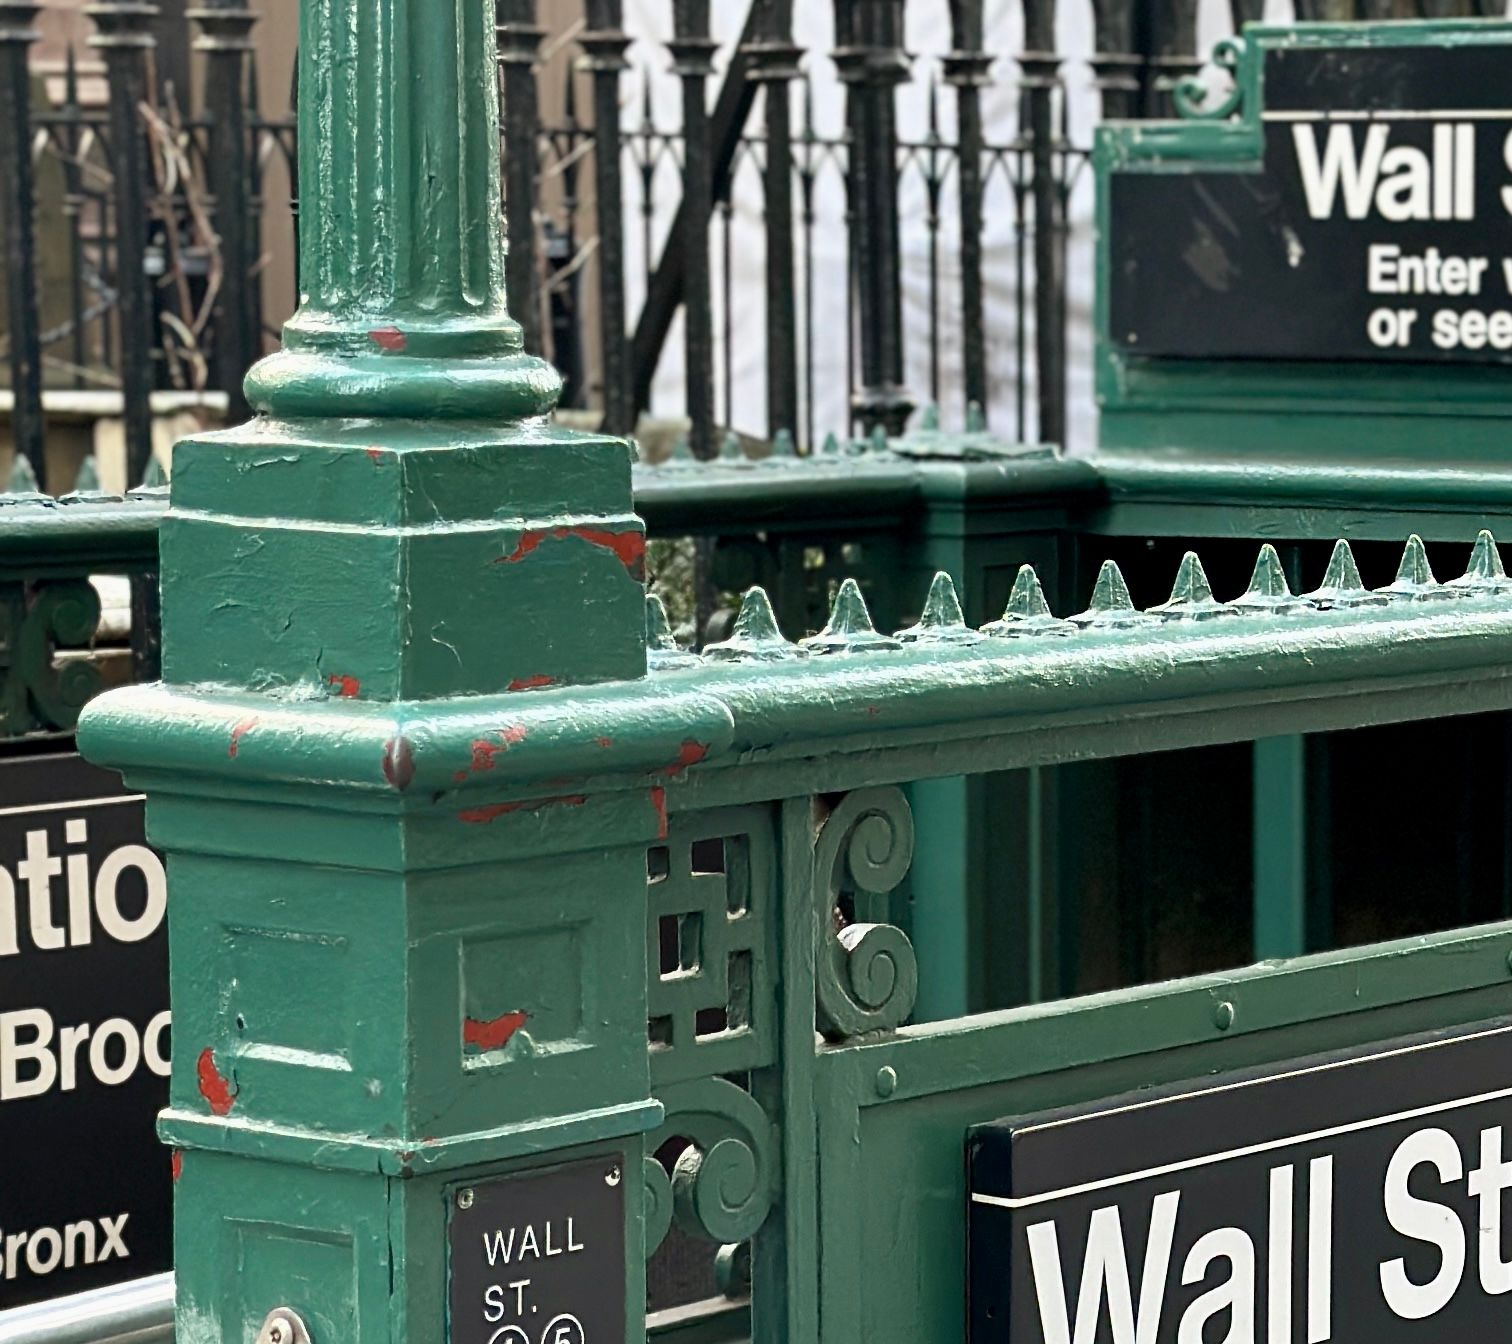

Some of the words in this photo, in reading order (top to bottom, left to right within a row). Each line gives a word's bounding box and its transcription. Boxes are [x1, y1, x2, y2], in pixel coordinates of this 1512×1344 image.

[1291, 122, 1476, 220] Wall
[1368, 244, 1488, 295] Enter
[1367, 309, 1417, 347] or
[0, 1212, 131, 1280] ronx
[483, 1217, 585, 1267] WALL
[483, 1278, 539, 1322] ST.
